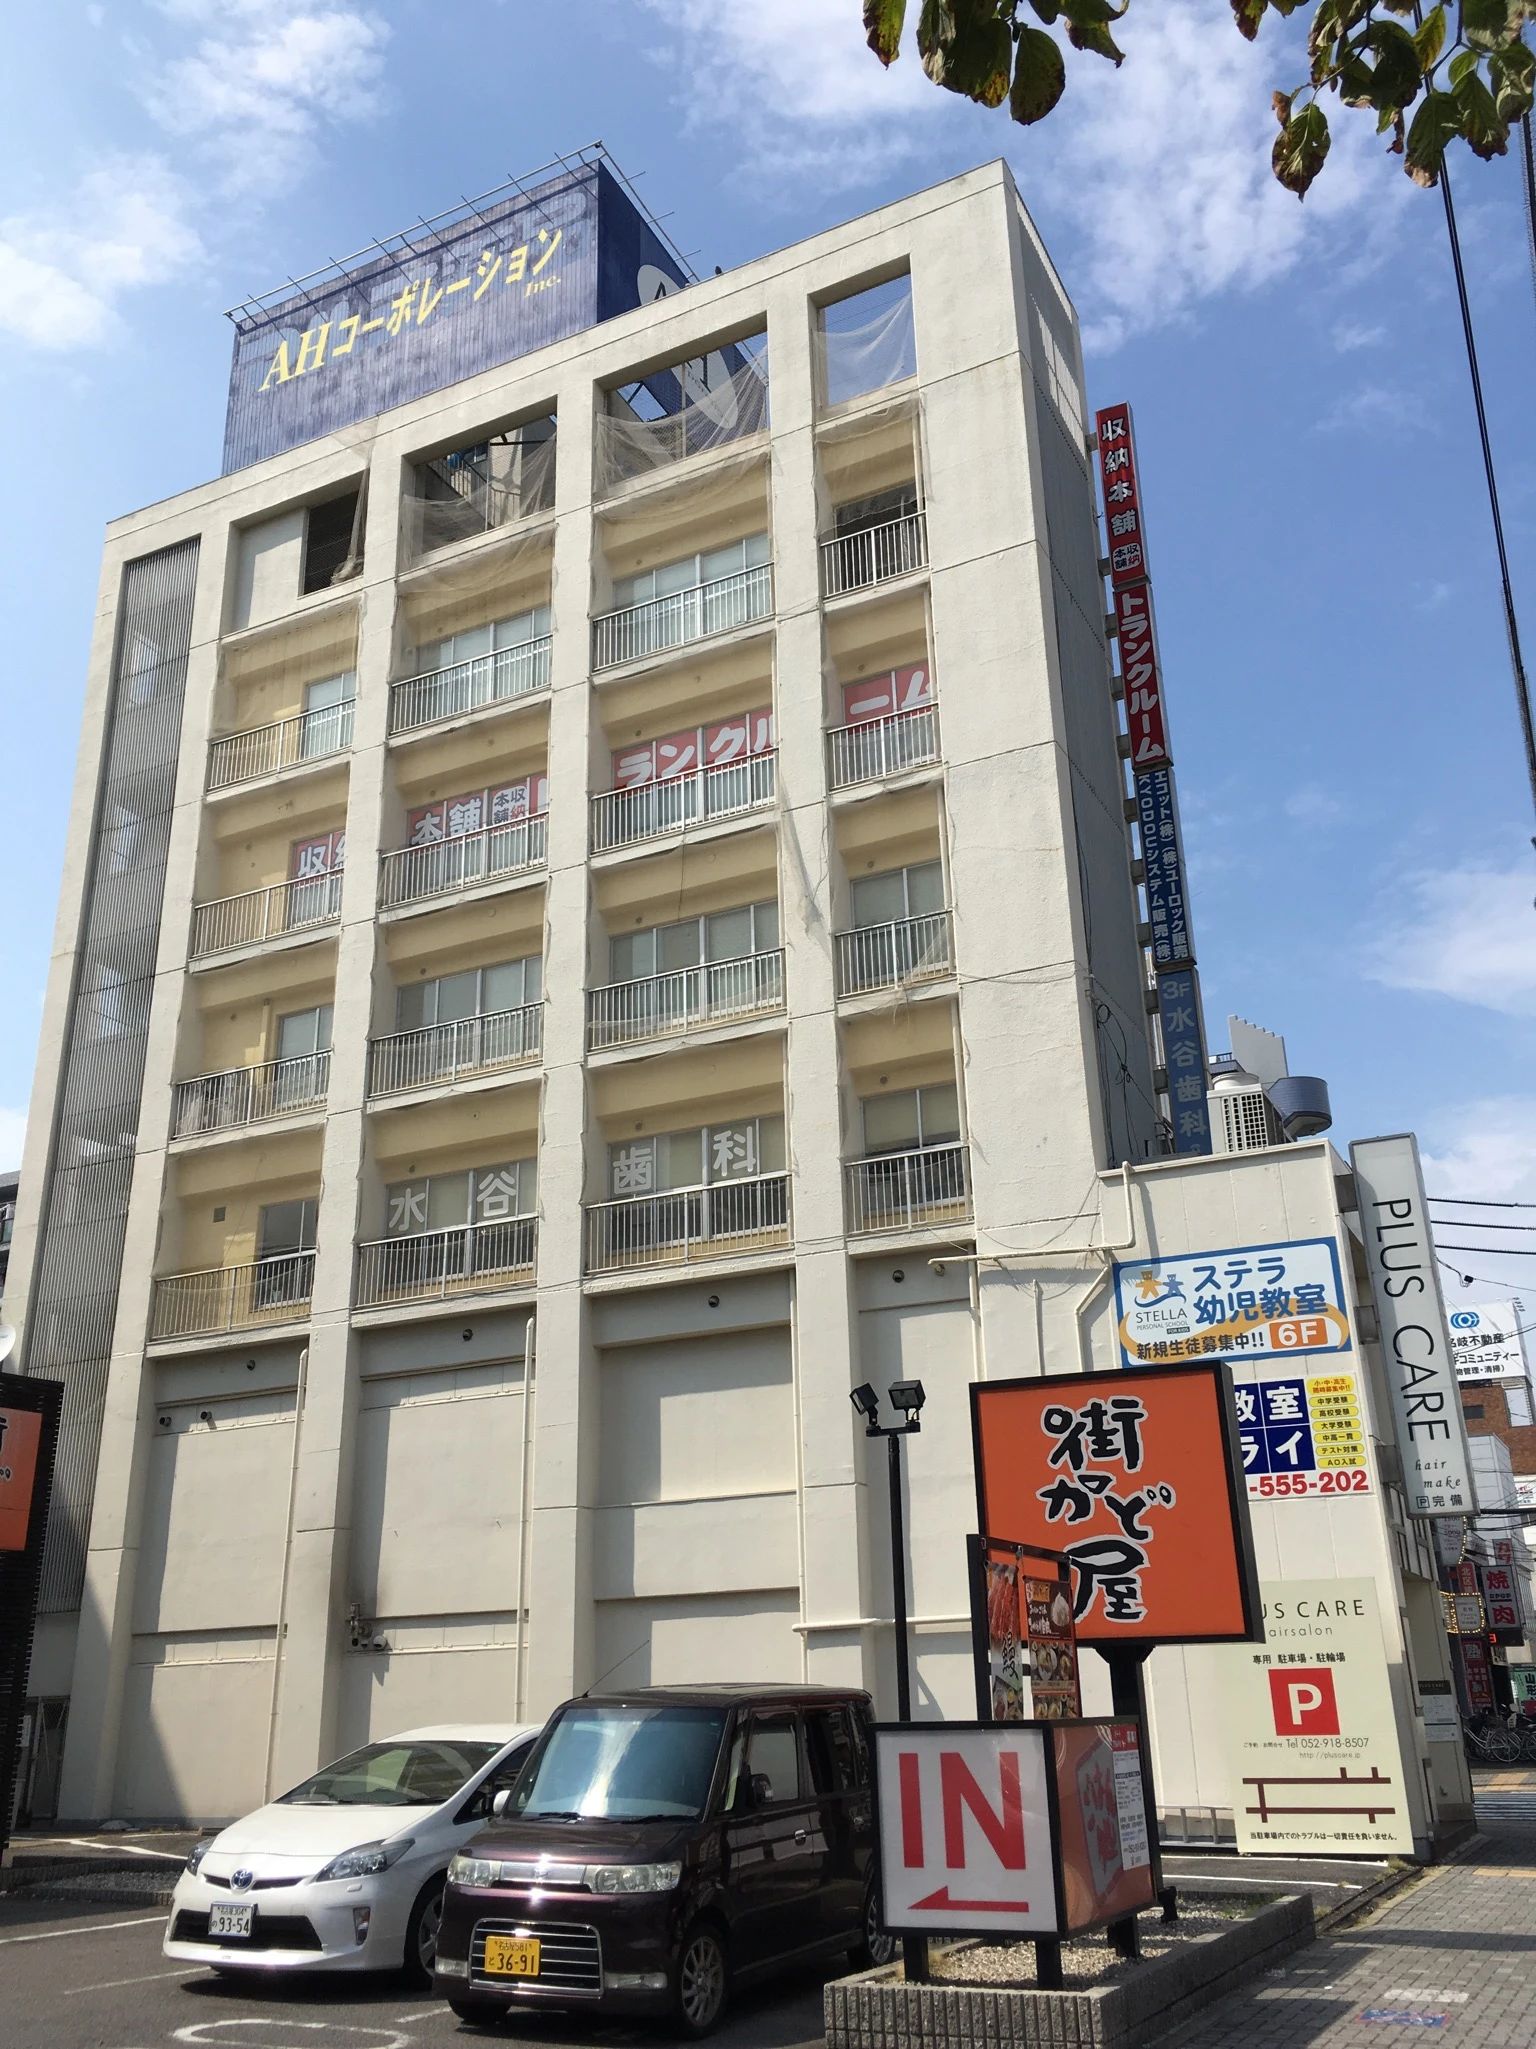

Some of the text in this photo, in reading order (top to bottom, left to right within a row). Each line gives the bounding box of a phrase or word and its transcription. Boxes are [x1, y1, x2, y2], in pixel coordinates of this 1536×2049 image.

[524, 275, 562, 298] Inc.
[258, 228, 563, 392] AHコーポレーション
[1102, 418, 1137, 537] 収納本舗
[1121, 593, 1165, 763] トランクルーム
[1162, 981, 1191, 1000] 3F
[1166, 1006, 1208, 1138] 水谷歯科
[389, 1125, 758, 1231] 水谷 歯科
[1193, 1256, 1287, 1293] ステラ
[1135, 1308, 1188, 1324] STELLA
[1194, 1283, 1329, 1326] 幼児教室
[1372, 1198, 1450, 1442] PLUS CARE
[1137, 1322, 1319, 1360] 新規生徒募集中!! 6F
[1415, 1459, 1448, 1471] hair
[1424, 1475, 1461, 1489] make
[1038, 1474, 1173, 1540] かど
[1066, 1538, 1146, 1620] 屋
[1296, 1600, 1365, 1618] CARE
[1252, 1654, 1272, 1665] 専用
[1287, 1683, 1323, 1726] P
[1286, 1738, 1298, 1749] Tel
[1301, 1737, 1369, 1749] 052-918-8507
[898, 1751, 1027, 1870] IN
[218, 1916, 250, 1934] 93-54
[496, 1952, 535, 1973] 36-91
